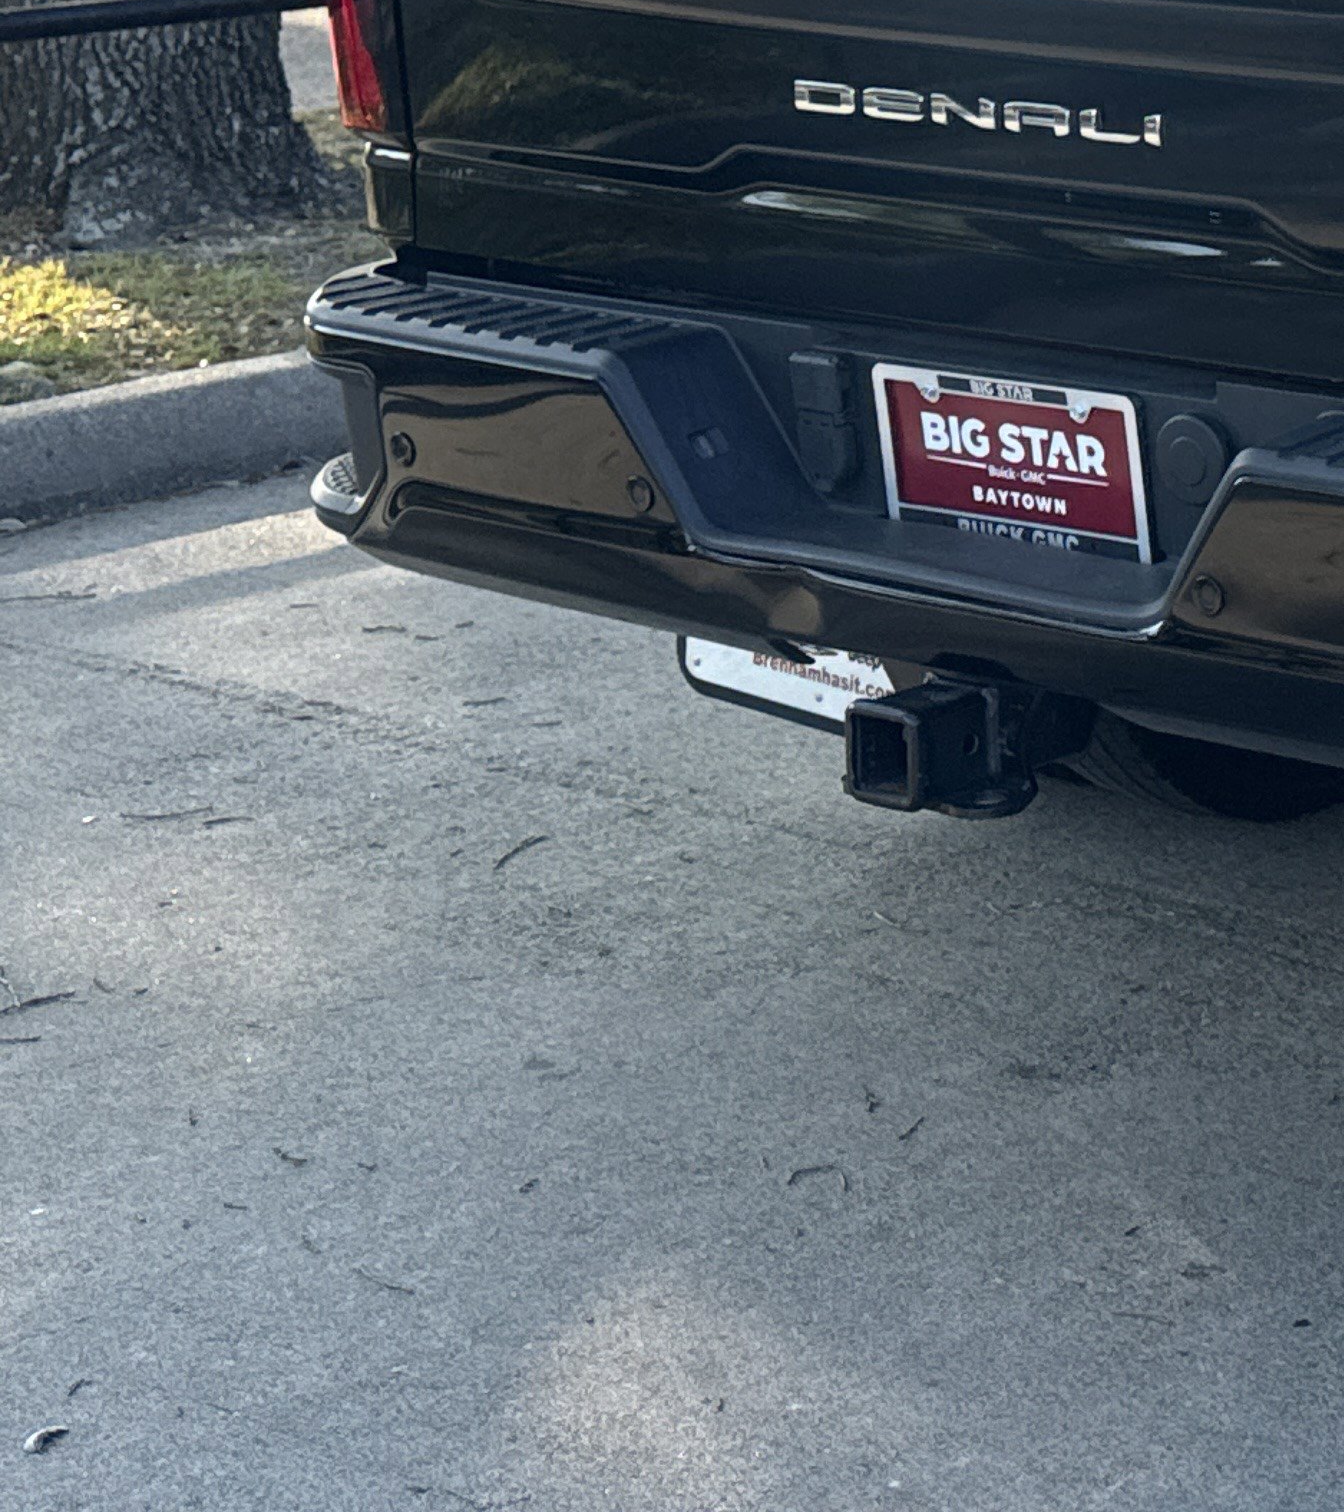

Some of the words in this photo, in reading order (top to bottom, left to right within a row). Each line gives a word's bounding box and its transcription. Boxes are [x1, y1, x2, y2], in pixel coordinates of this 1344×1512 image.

[794, 79, 1163, 147] DENALI
[970, 380, 995, 395] BIG
[997, 384, 1034, 402] STAR
[920, 411, 990, 458] BIG
[997, 423, 1108, 477] STAR
[973, 486, 1067, 515] BAYTOWN
